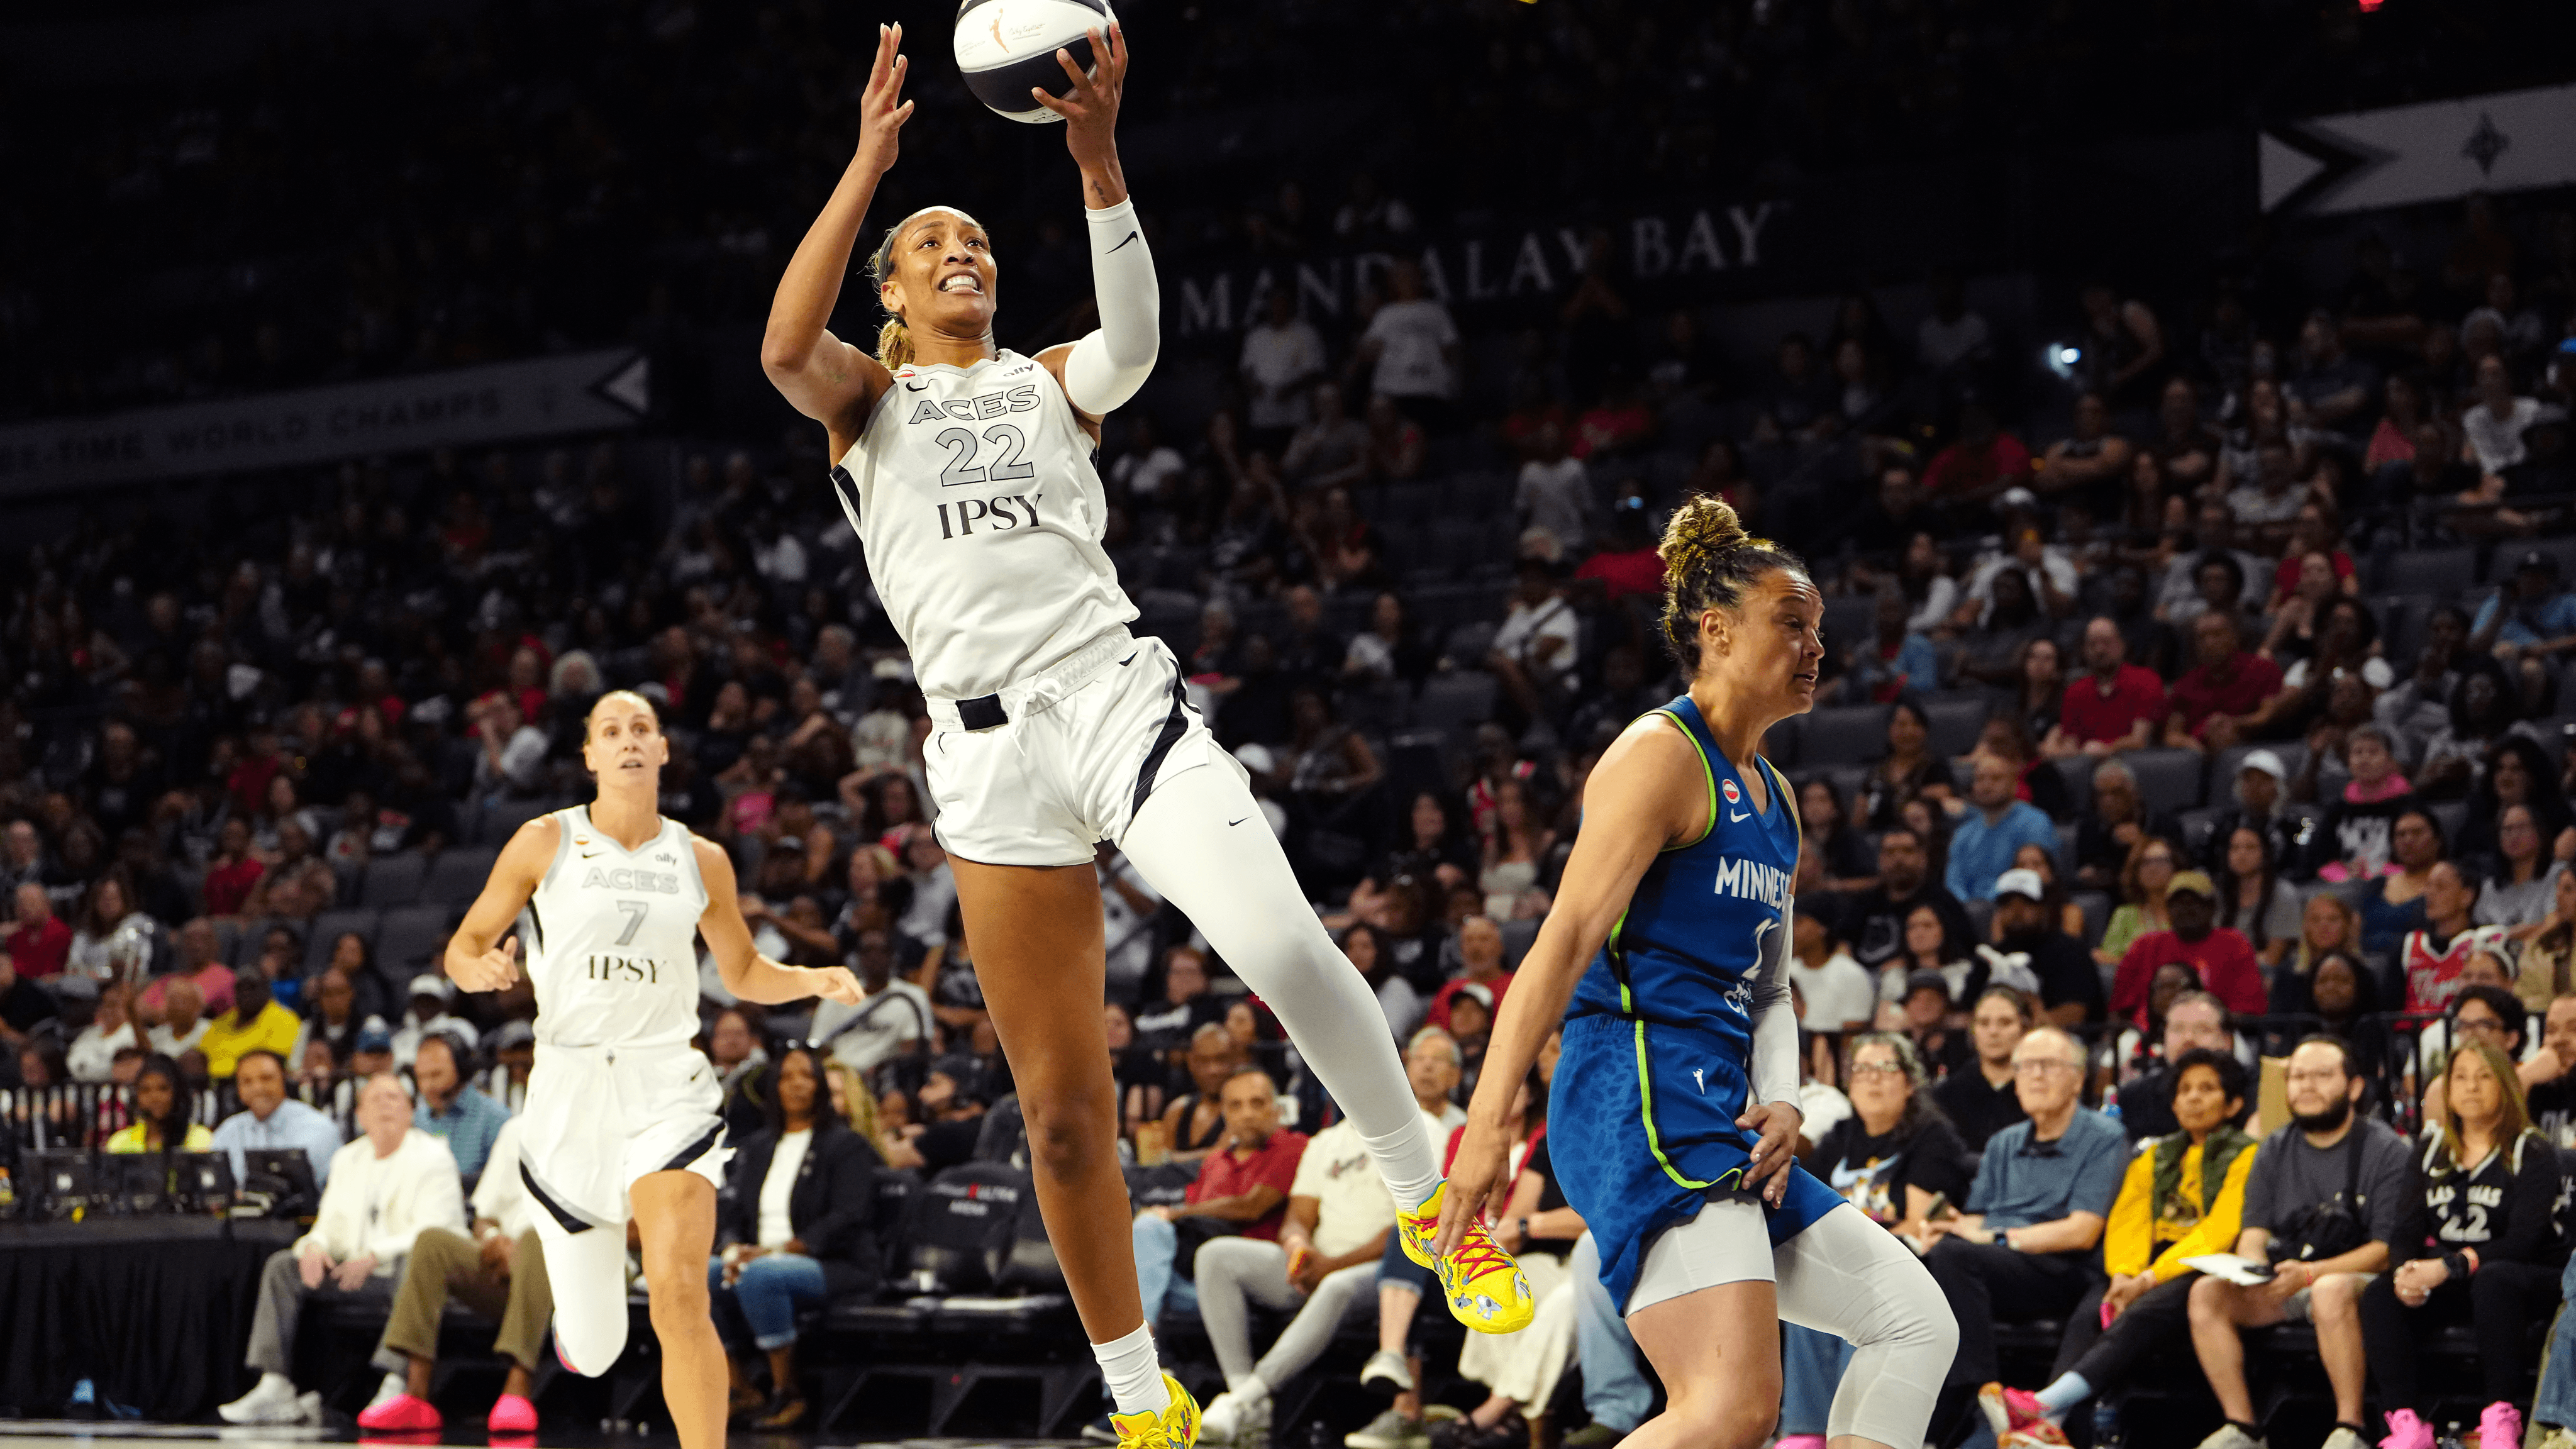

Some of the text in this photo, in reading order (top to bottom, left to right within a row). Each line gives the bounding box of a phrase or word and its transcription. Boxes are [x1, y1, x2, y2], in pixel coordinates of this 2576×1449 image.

[1633, 200, 1775, 278] BAY
[1002, 364, 1034, 377] ally
[167, 413, 311, 454] WORLD
[328, 387, 502, 437] CHAMPS
[909, 384, 1040, 425] ACES
[935, 424, 1034, 487] 22
[936, 494, 1043, 540] IPSY
[581, 867, 679, 894] ACES
[655, 852, 677, 866] ally
[614, 899, 648, 945] 7
[588, 955, 667, 984] IPSY
